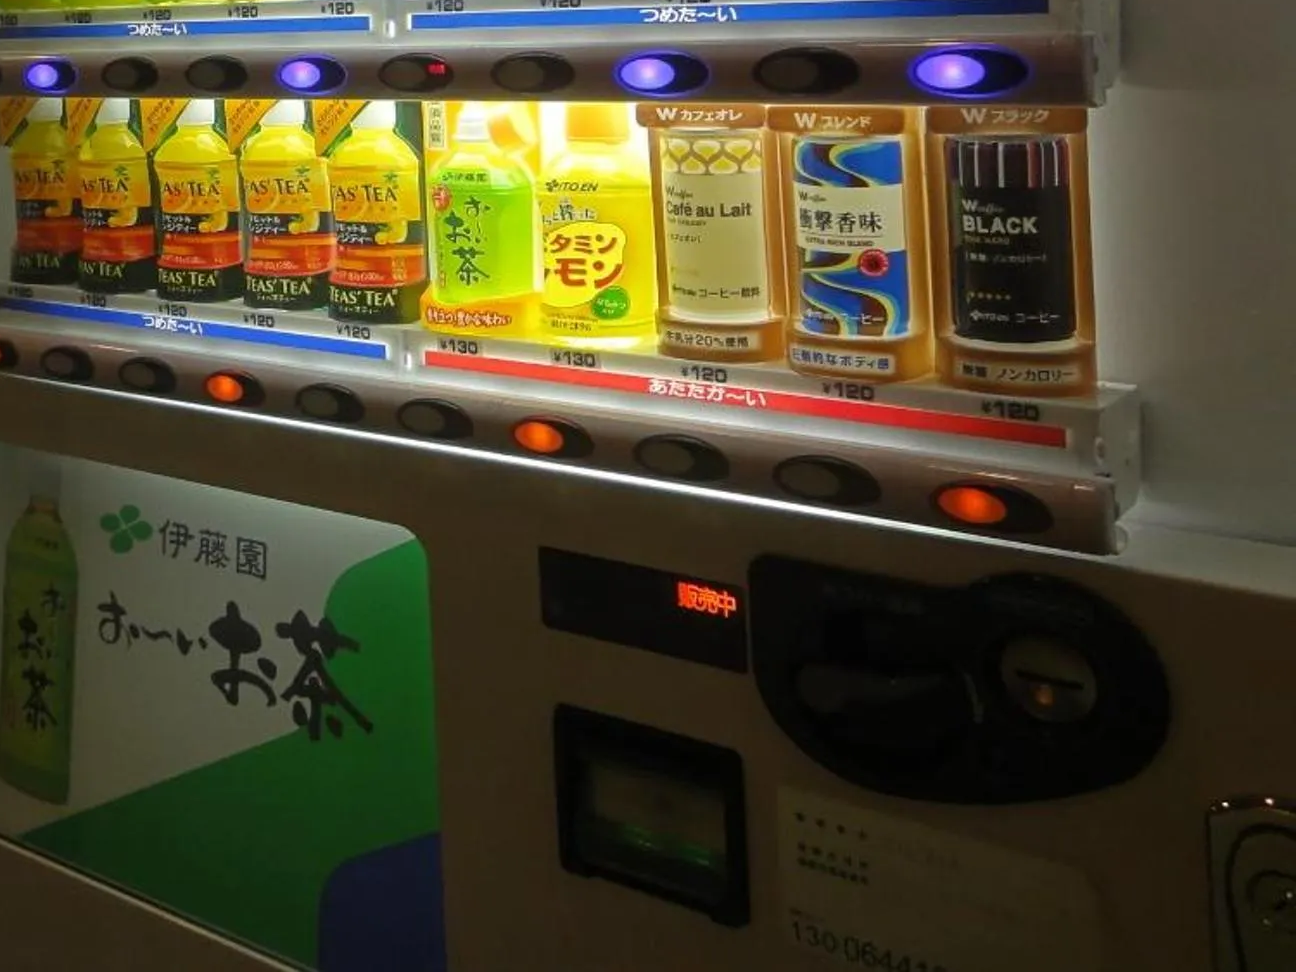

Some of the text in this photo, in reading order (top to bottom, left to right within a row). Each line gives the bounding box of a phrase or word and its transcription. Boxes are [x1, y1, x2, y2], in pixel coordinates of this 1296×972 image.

[321, 2, 355, 16] ¥120
[426, 0, 464, 12] ¥120
[656, 107, 743, 123] W カフェオレ
[794, 113, 817, 129] W
[961, 108, 987, 124] W
[99, 177, 128, 193] TEA
[188, 181, 221, 196] TEA
[275, 178, 309, 194] TEA
[558, 182, 598, 191] ITO EN
[363, 185, 397, 203] TEA
[666, 200, 752, 218] Café au Lait
[800, 207, 883, 234] 衝撃香味
[962, 214, 1039, 234] BLACK
[443, 211, 490, 286] お茶
[189, 271, 217, 287] TEA
[544, 257, 623, 289] モン
[246, 276, 310, 295] TEAS' TEA
[329, 286, 395, 307] TEAS' TEA
[243, 315, 275, 328] ¥120
[1015, 312, 1061, 324] コーヒー
[336, 324, 371, 340] ¥120
[440, 338, 478, 355] ¥130
[553, 350, 596, 367] ¥130
[680, 365, 729, 383] ¥120
[996, 367, 1076, 382] ノンカロリー
[821, 382, 875, 401] ¥120
[980, 402, 1040, 422] ¥120
[158, 518, 269, 580] 伊藤園
[677, 580, 737, 619] 販売中
